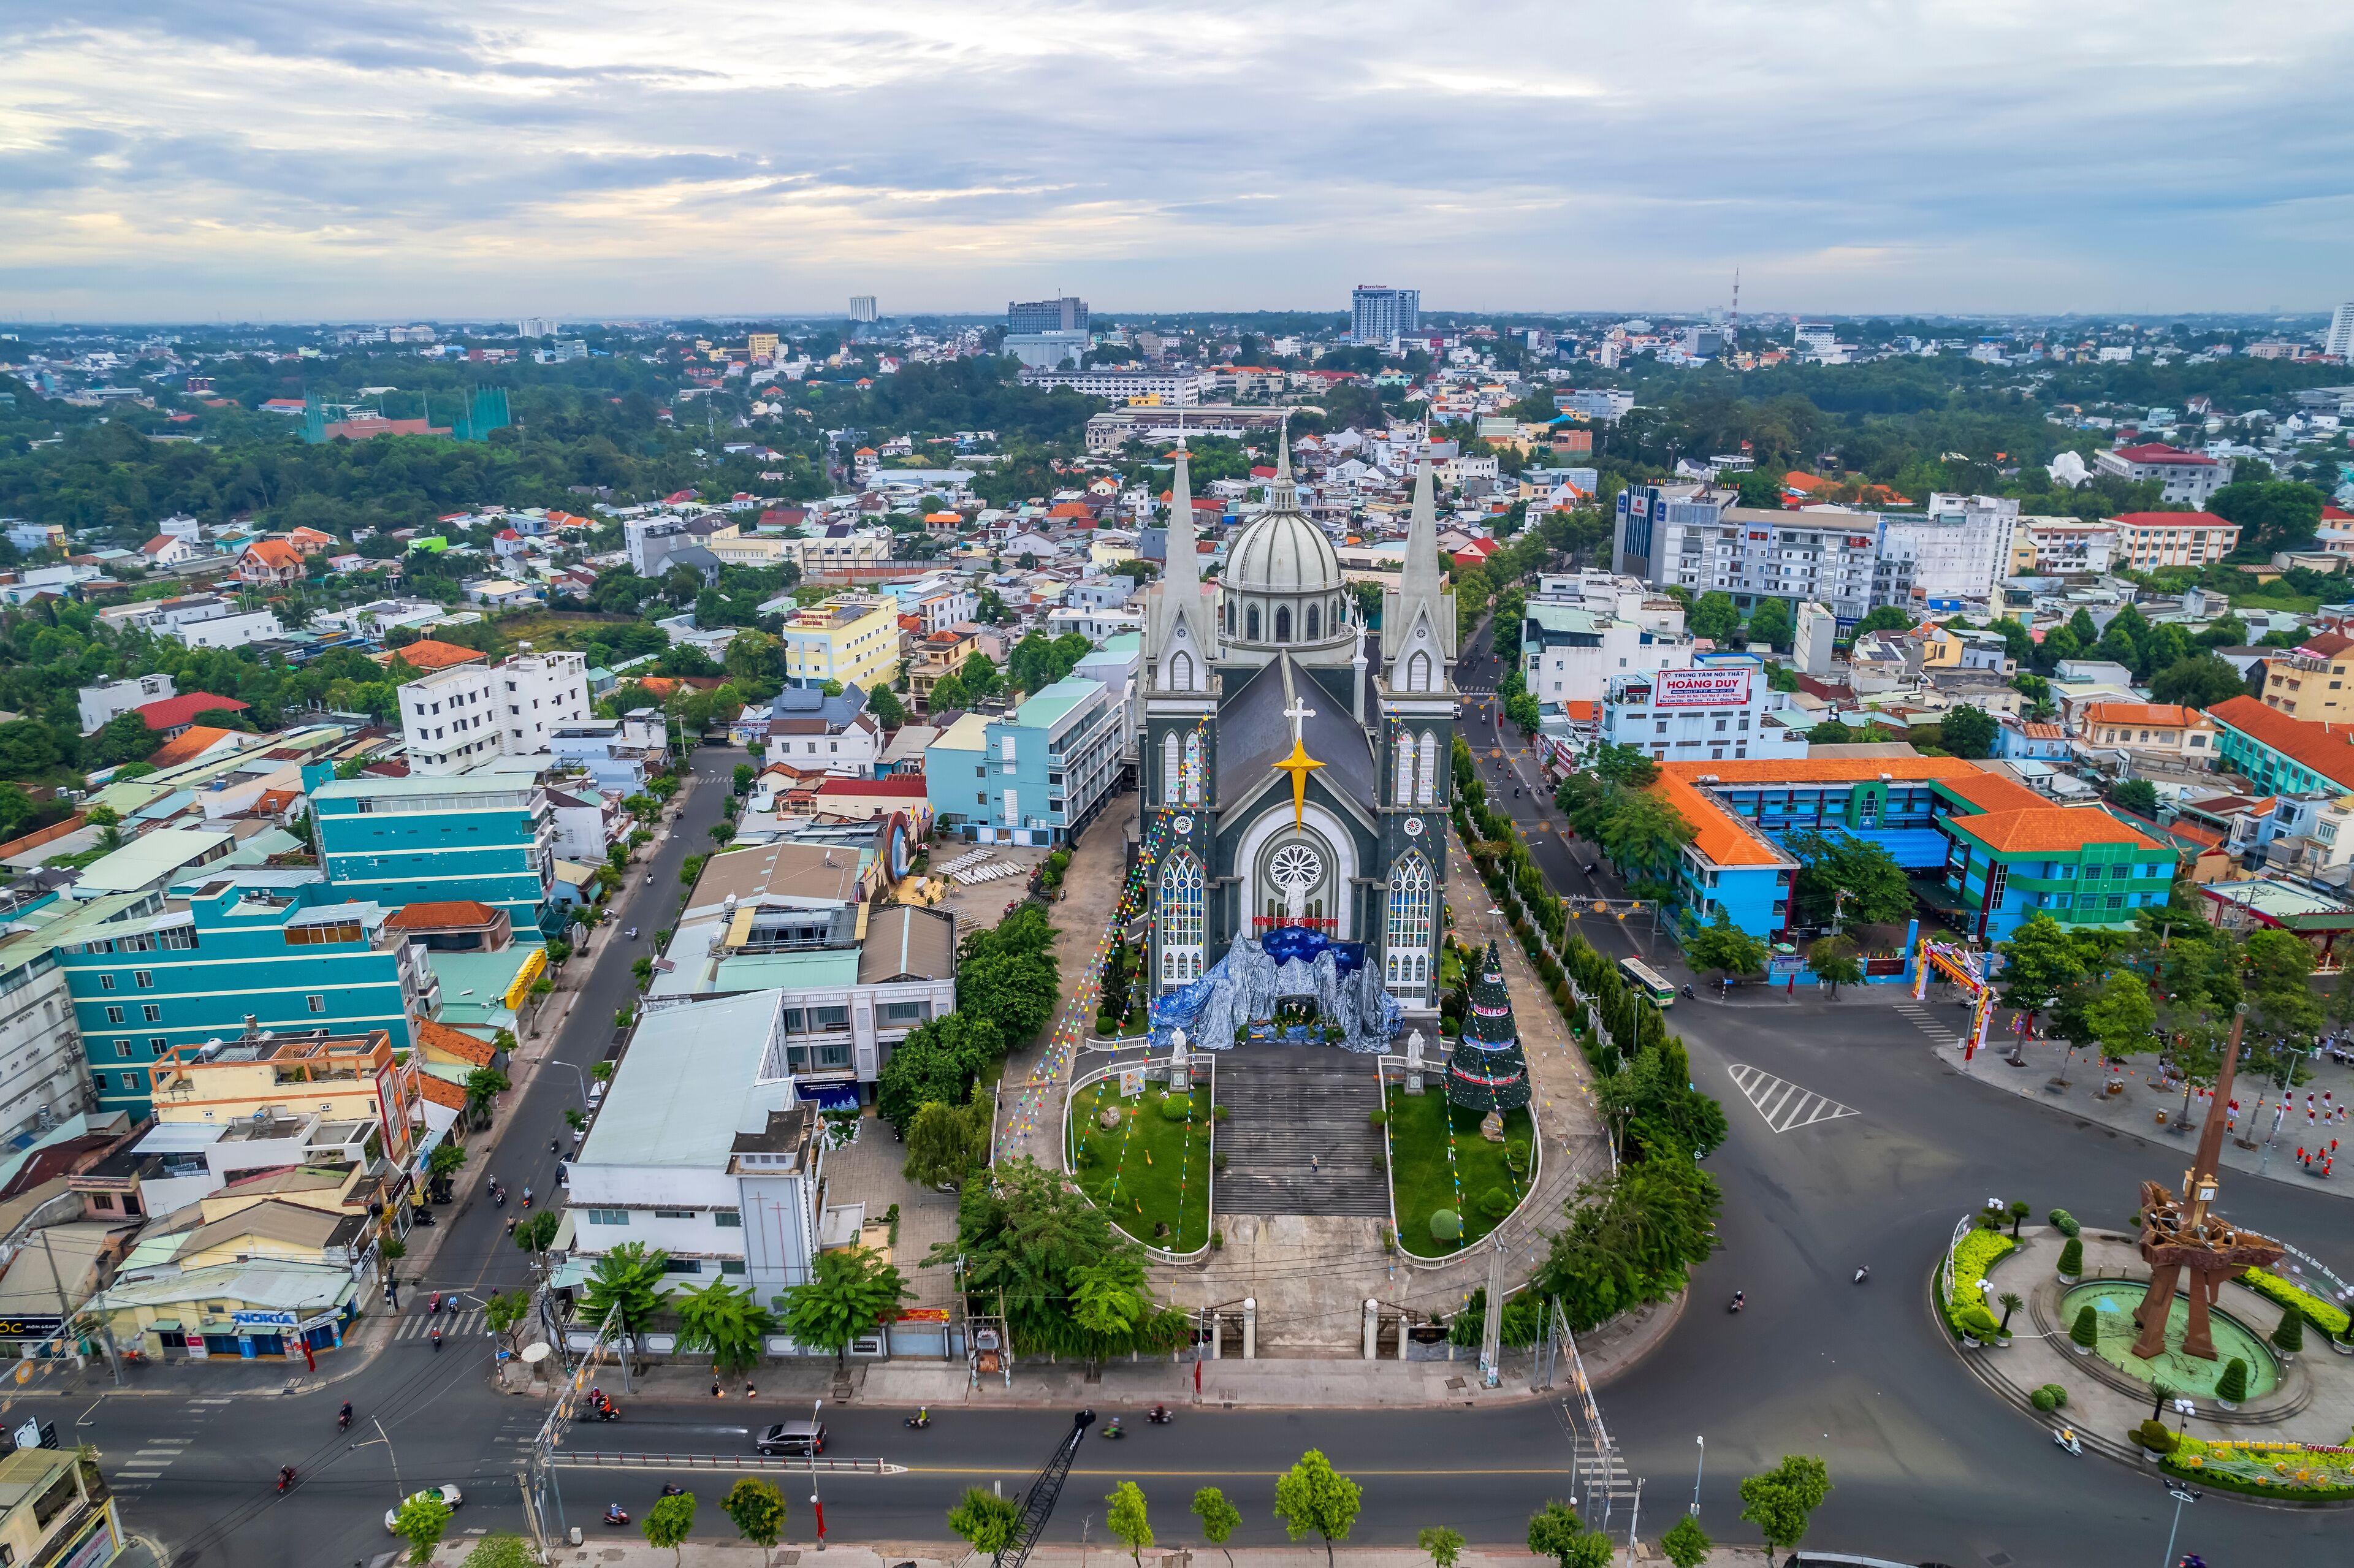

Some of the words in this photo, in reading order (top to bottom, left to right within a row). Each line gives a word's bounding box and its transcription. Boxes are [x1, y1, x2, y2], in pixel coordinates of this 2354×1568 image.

[1667, 679, 1712, 688] HOÀNG
[1322, 918, 1338, 927] SINH
[235, 1314, 295, 1324] NOKIA
